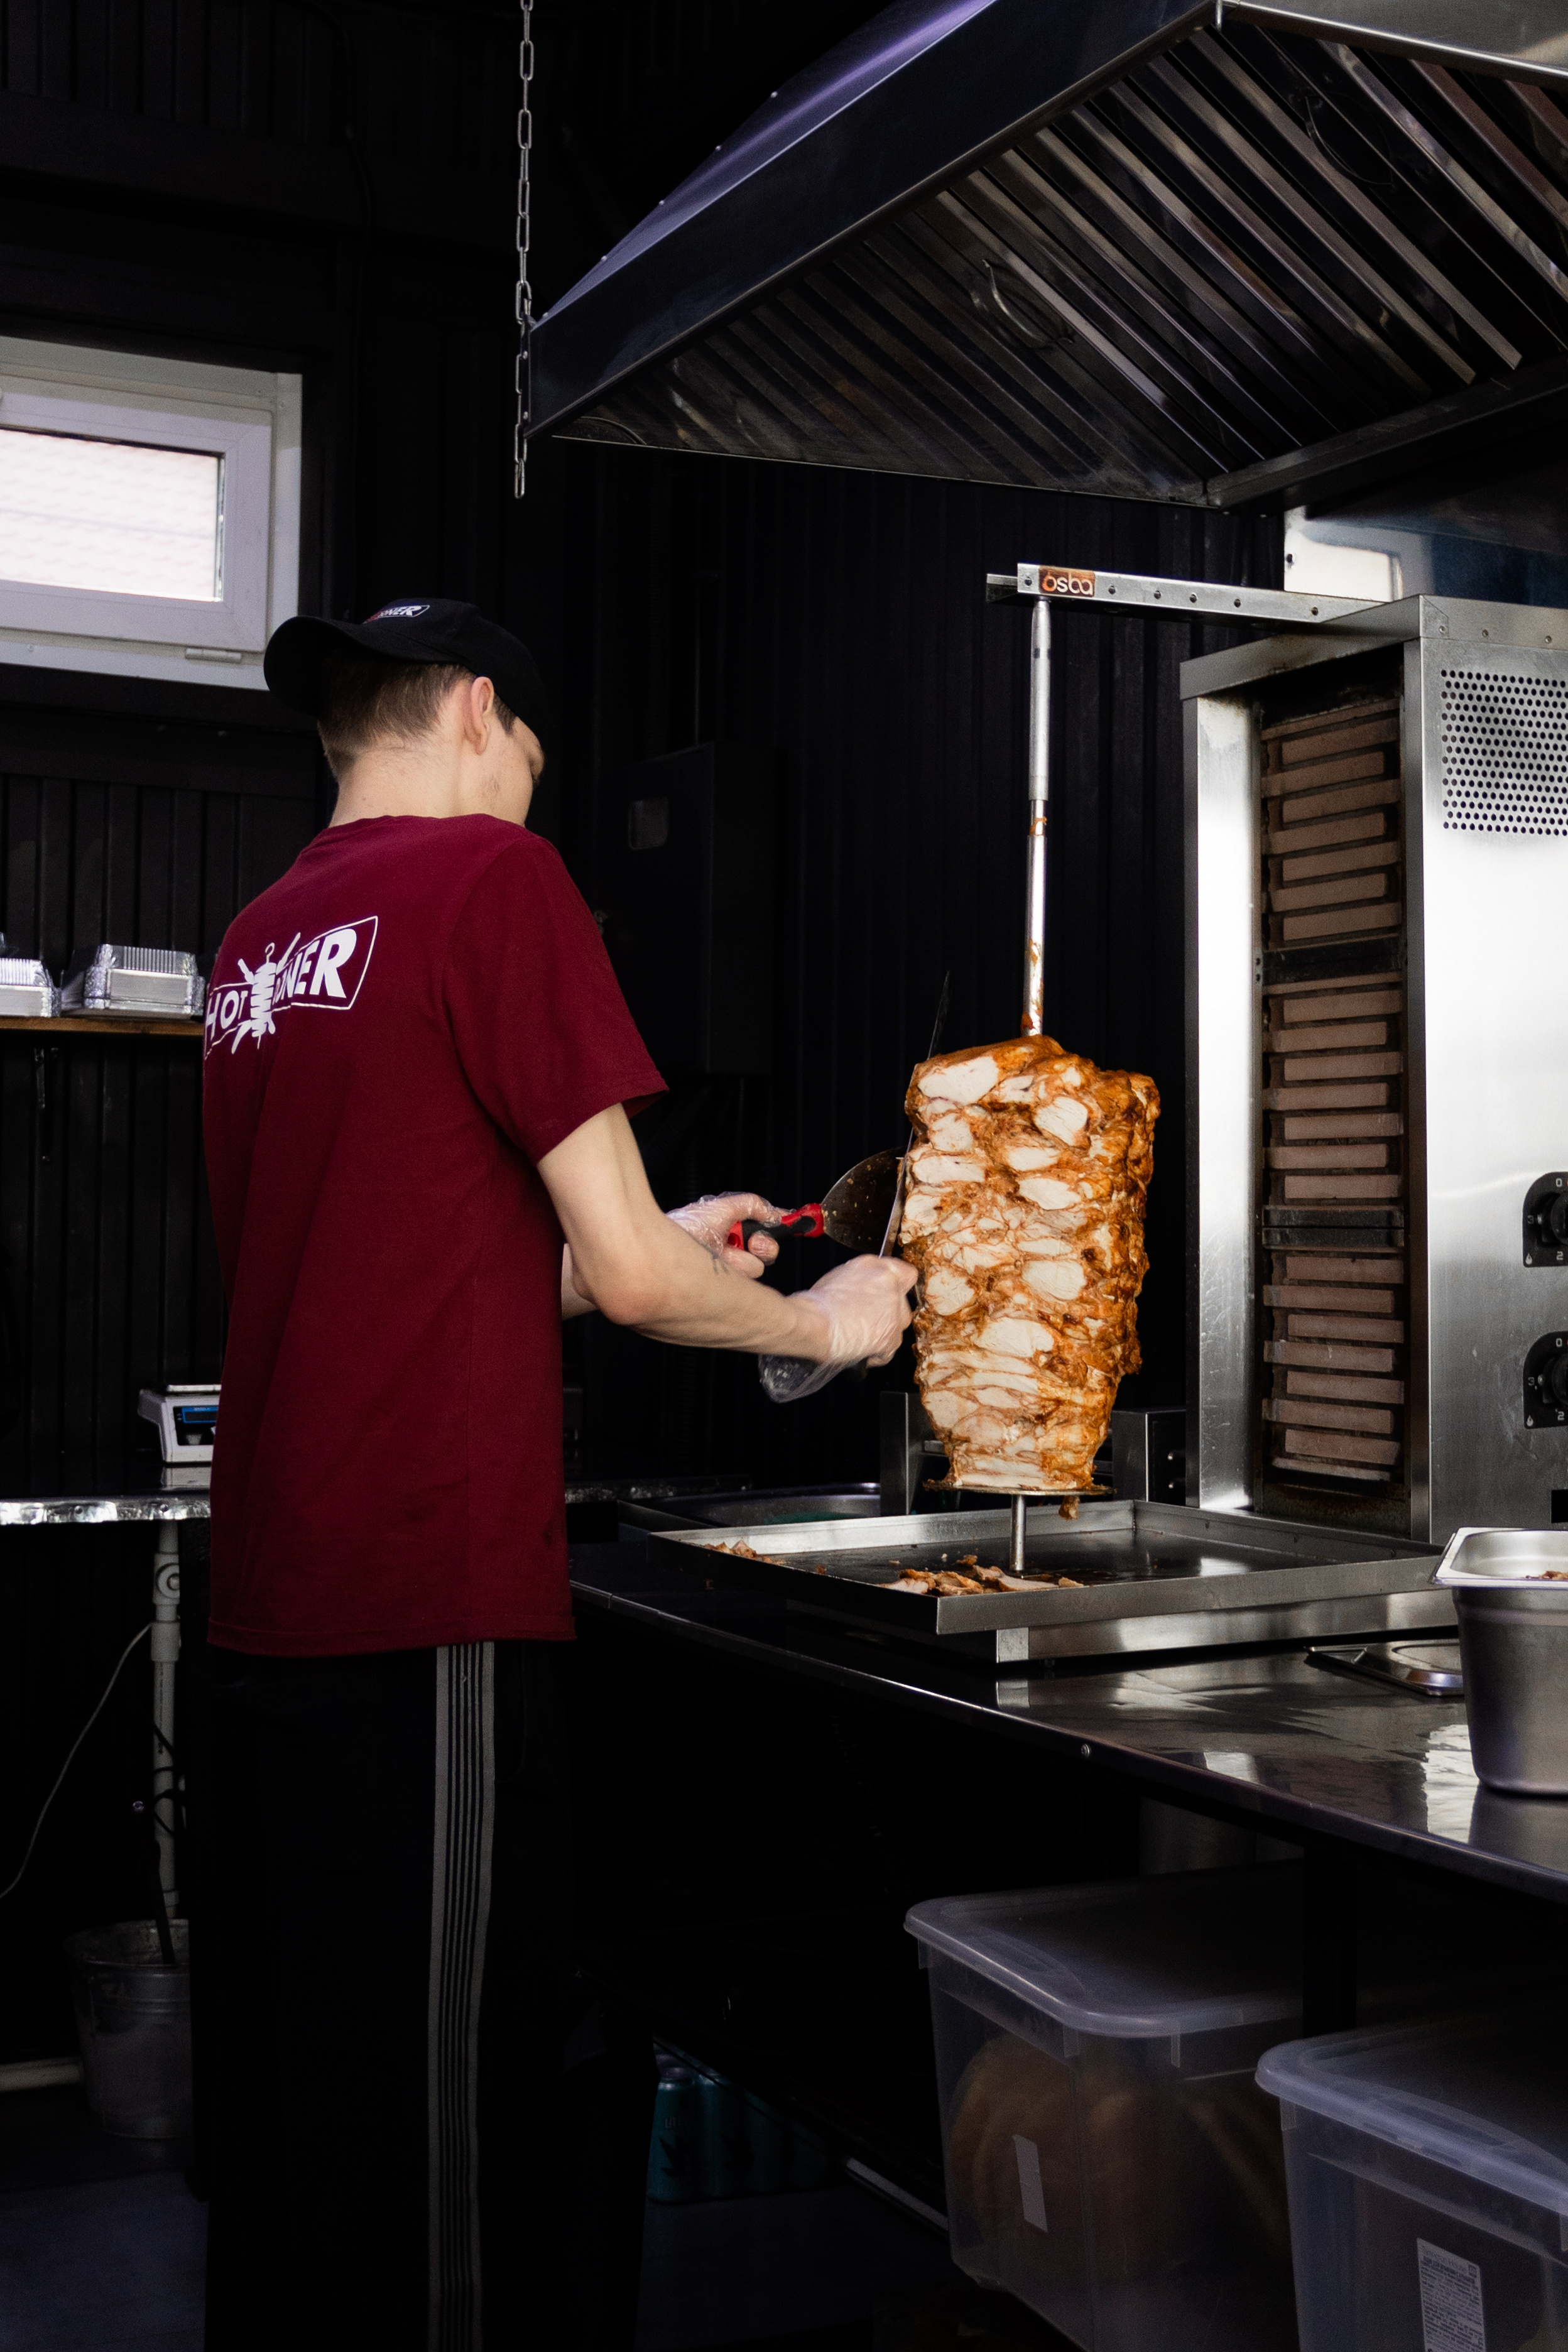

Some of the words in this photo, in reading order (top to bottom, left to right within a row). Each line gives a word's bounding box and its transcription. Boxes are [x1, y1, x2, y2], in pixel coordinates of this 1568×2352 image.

[205, 989, 248, 1041] HOT
[1527, 1215, 1534, 1224] 3
[1556, 1251, 1564, 1261] 2
[1528, 1376, 1535, 1386] 3
[1557, 1411, 1565, 1421] 2
